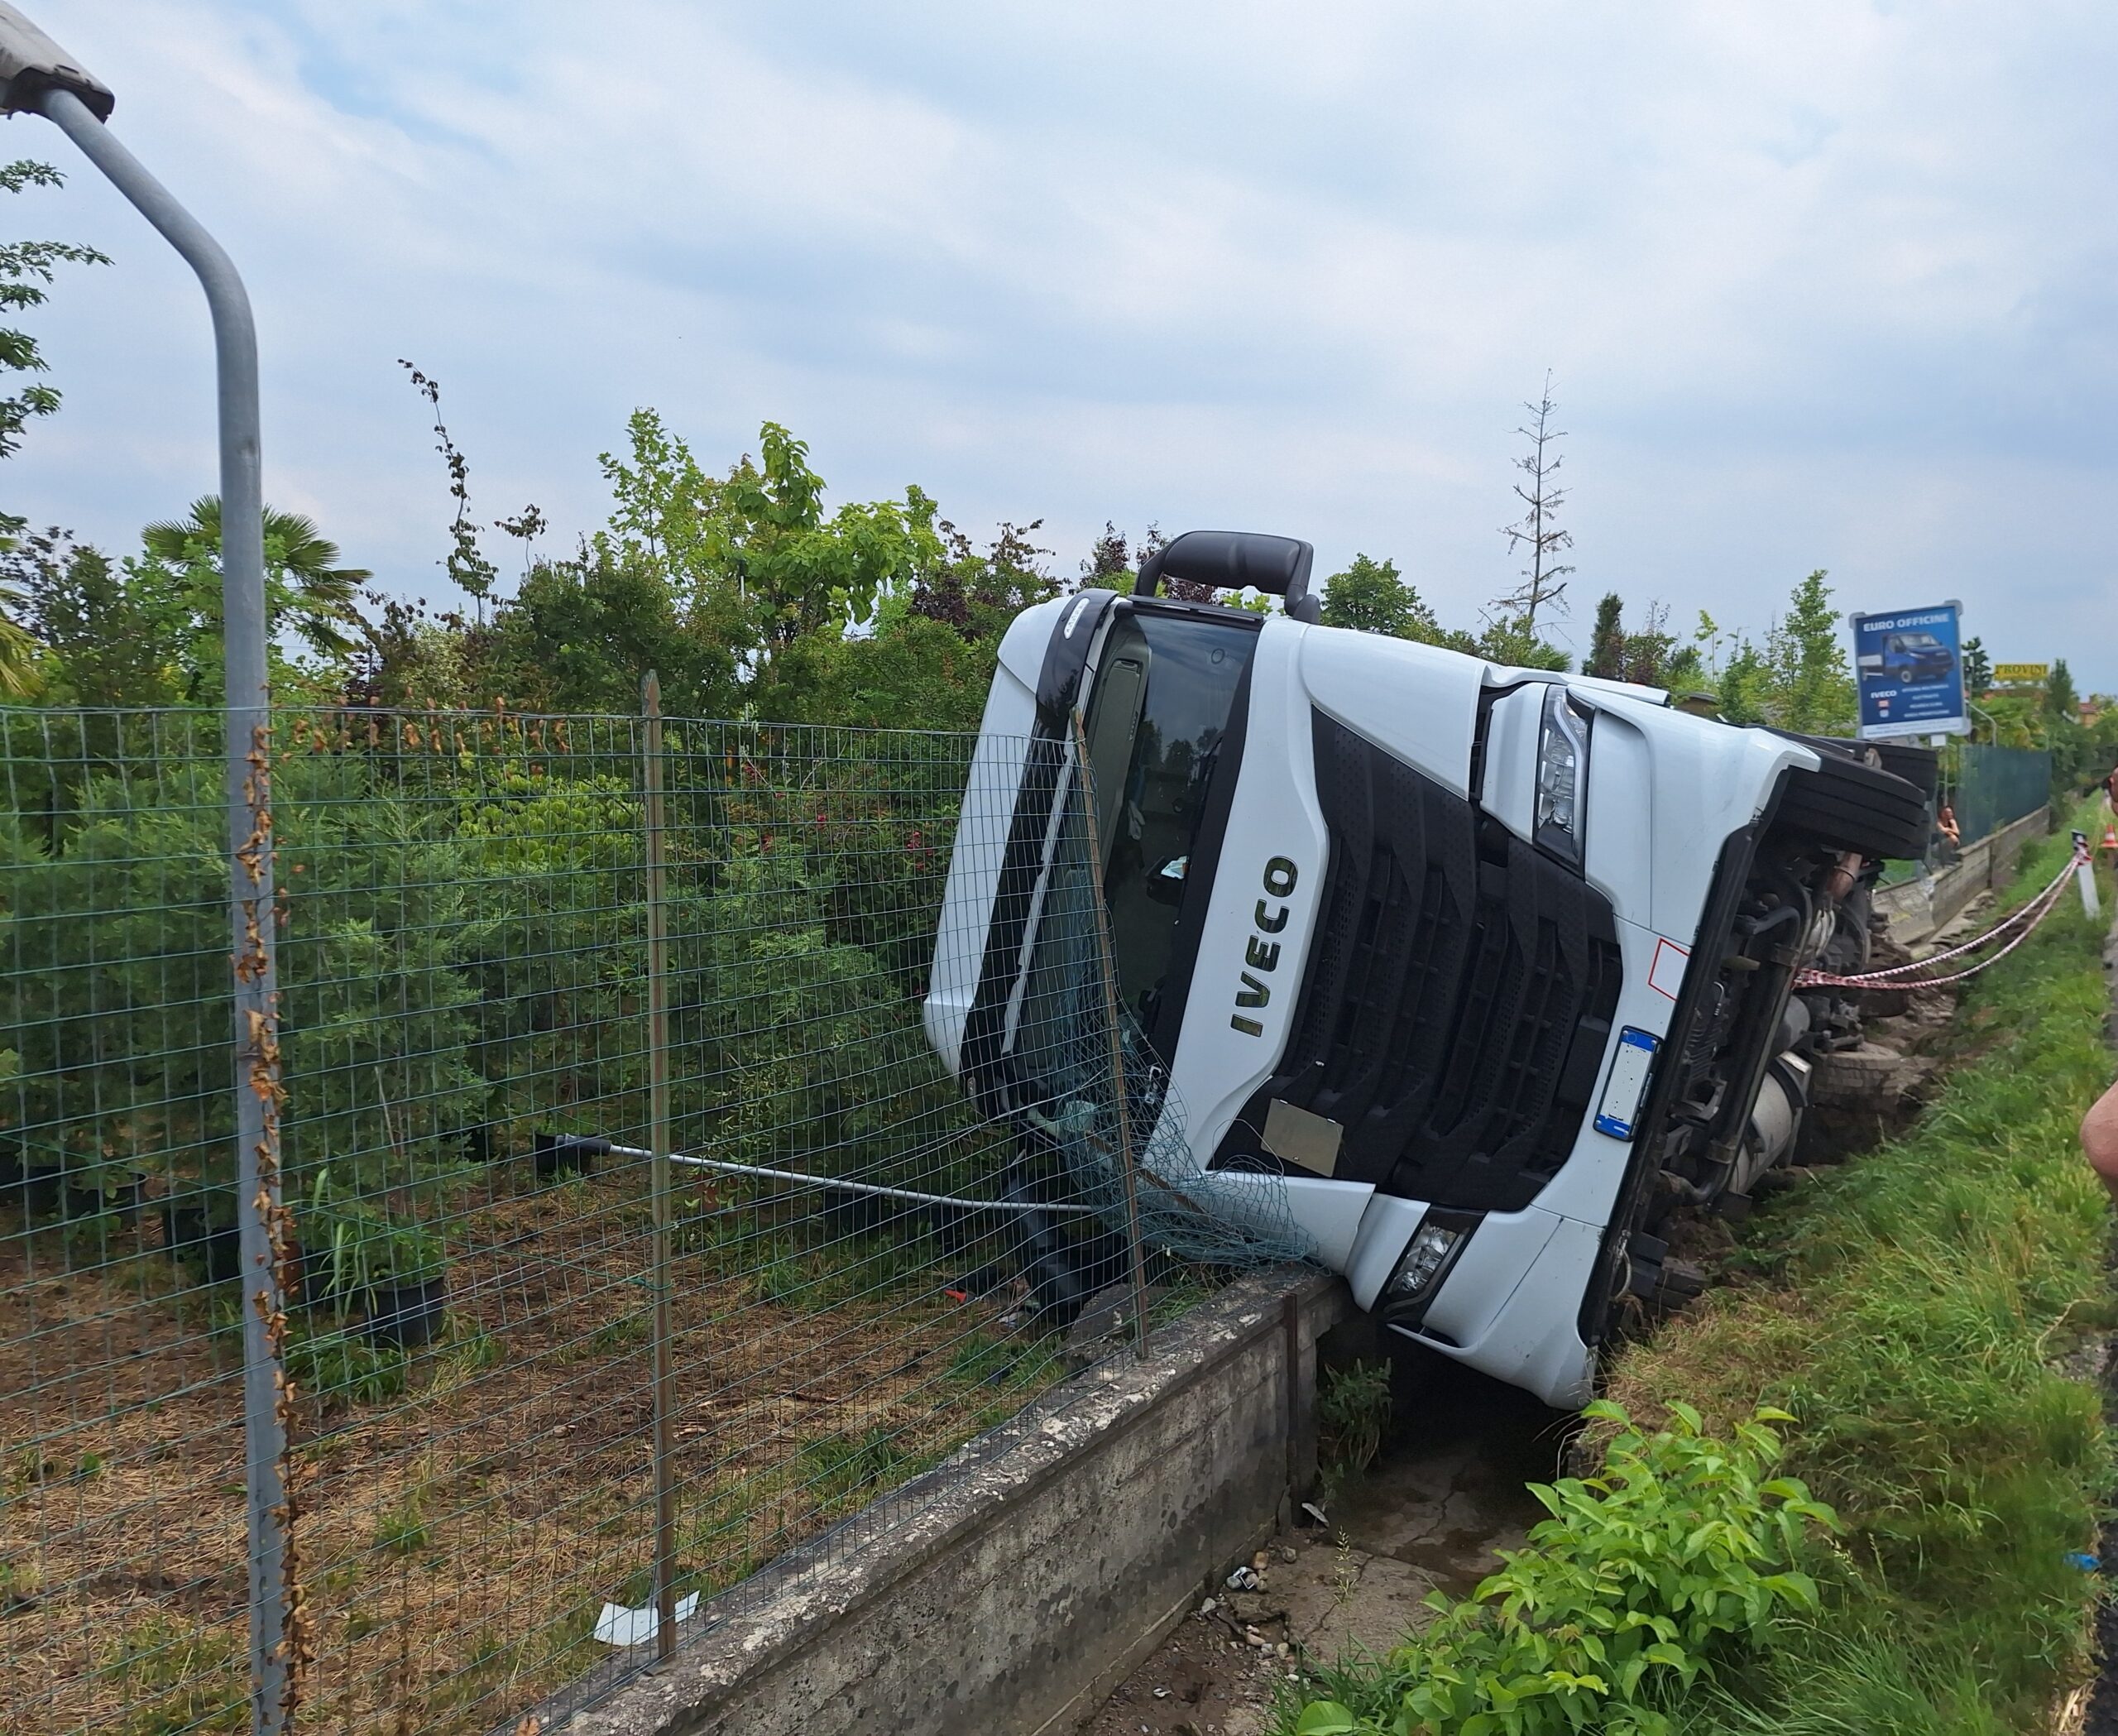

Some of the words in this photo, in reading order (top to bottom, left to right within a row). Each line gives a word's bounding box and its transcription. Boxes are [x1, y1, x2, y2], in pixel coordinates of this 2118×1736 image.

[1863, 620, 1895, 632] EURO
[1897, 613, 1949, 628] OFFICINE
[1996, 664, 2048, 675] PROVINI
[1871, 690, 1897, 698] IVECO
[1230, 855, 1299, 1038] IVECO
